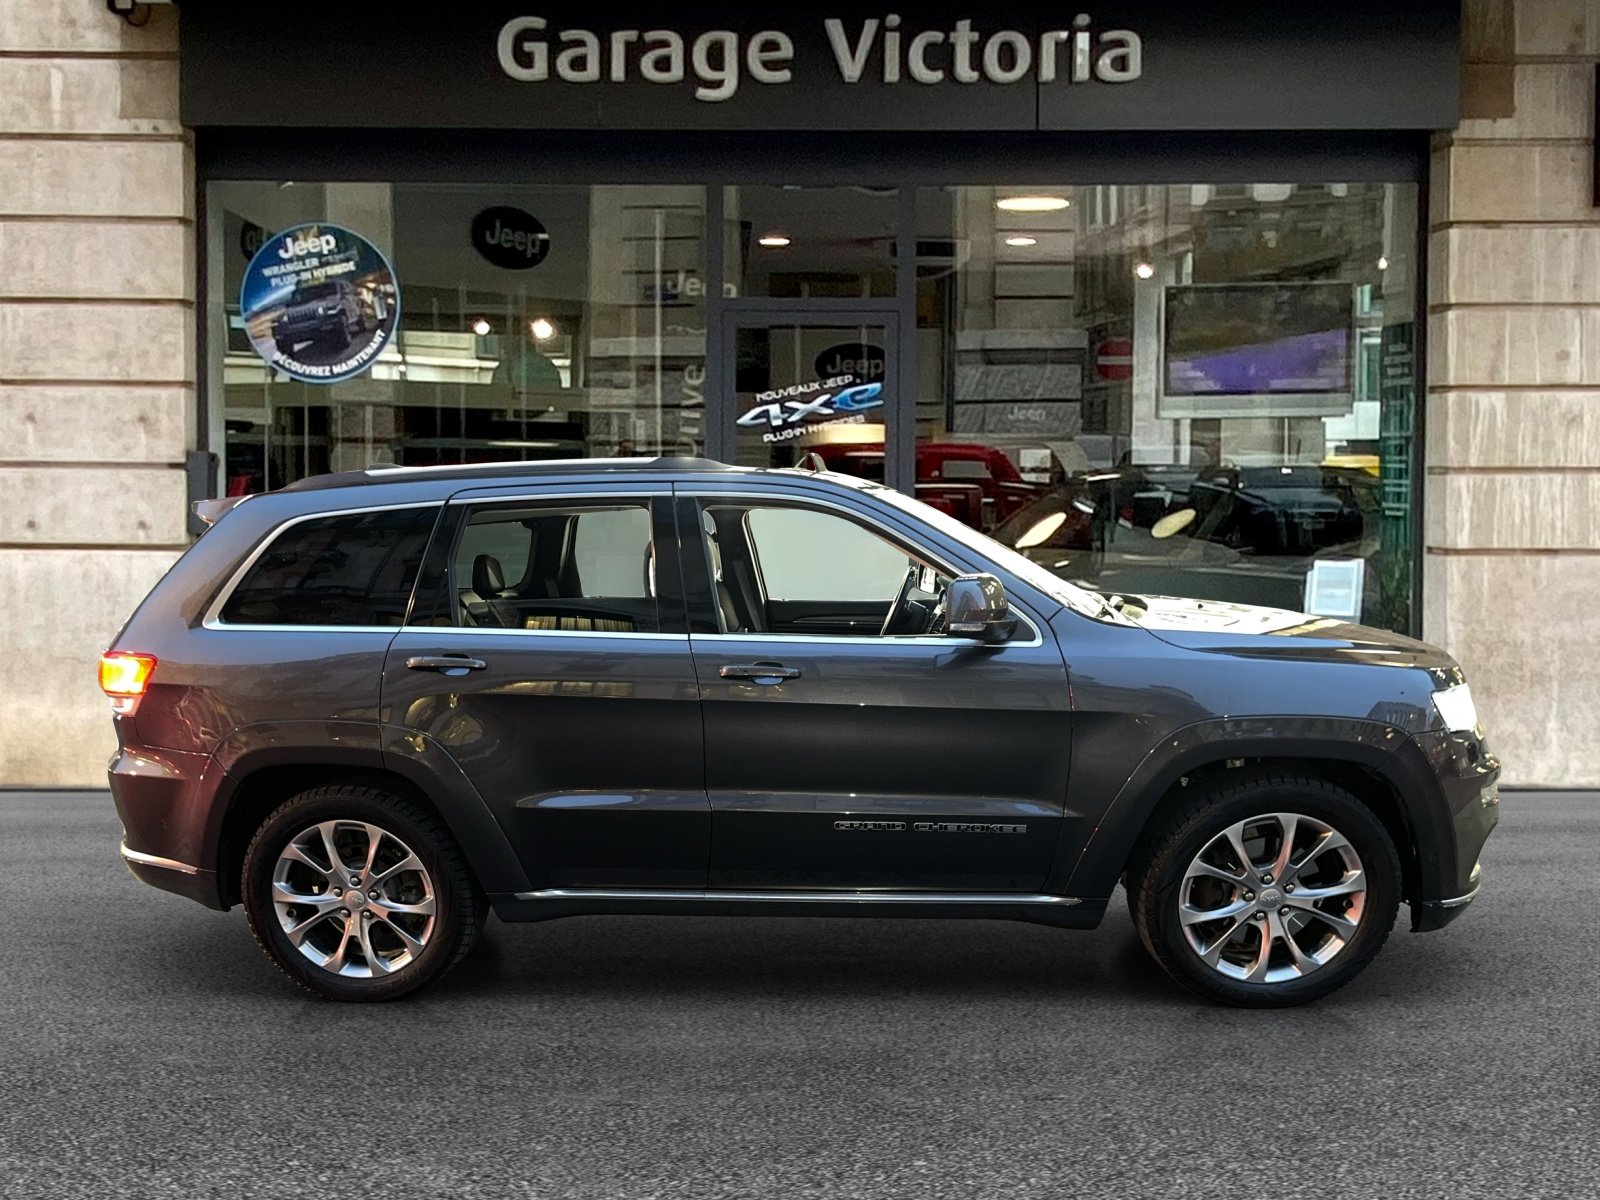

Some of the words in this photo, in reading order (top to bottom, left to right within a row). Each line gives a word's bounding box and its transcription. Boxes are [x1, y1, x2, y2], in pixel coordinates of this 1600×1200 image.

[497, 15, 794, 102] Garage
[824, 13, 1142, 83] Victoria
[278, 234, 336, 259] Jeep
[485, 219, 540, 258] Jeep
[826, 353, 884, 377] Jeep
[755, 380, 821, 402] NOUVEAUX
[823, 374, 854, 389] JEEP
[833, 820, 907, 831] GRAND
[913, 821, 1028, 833] CHEROKEE
